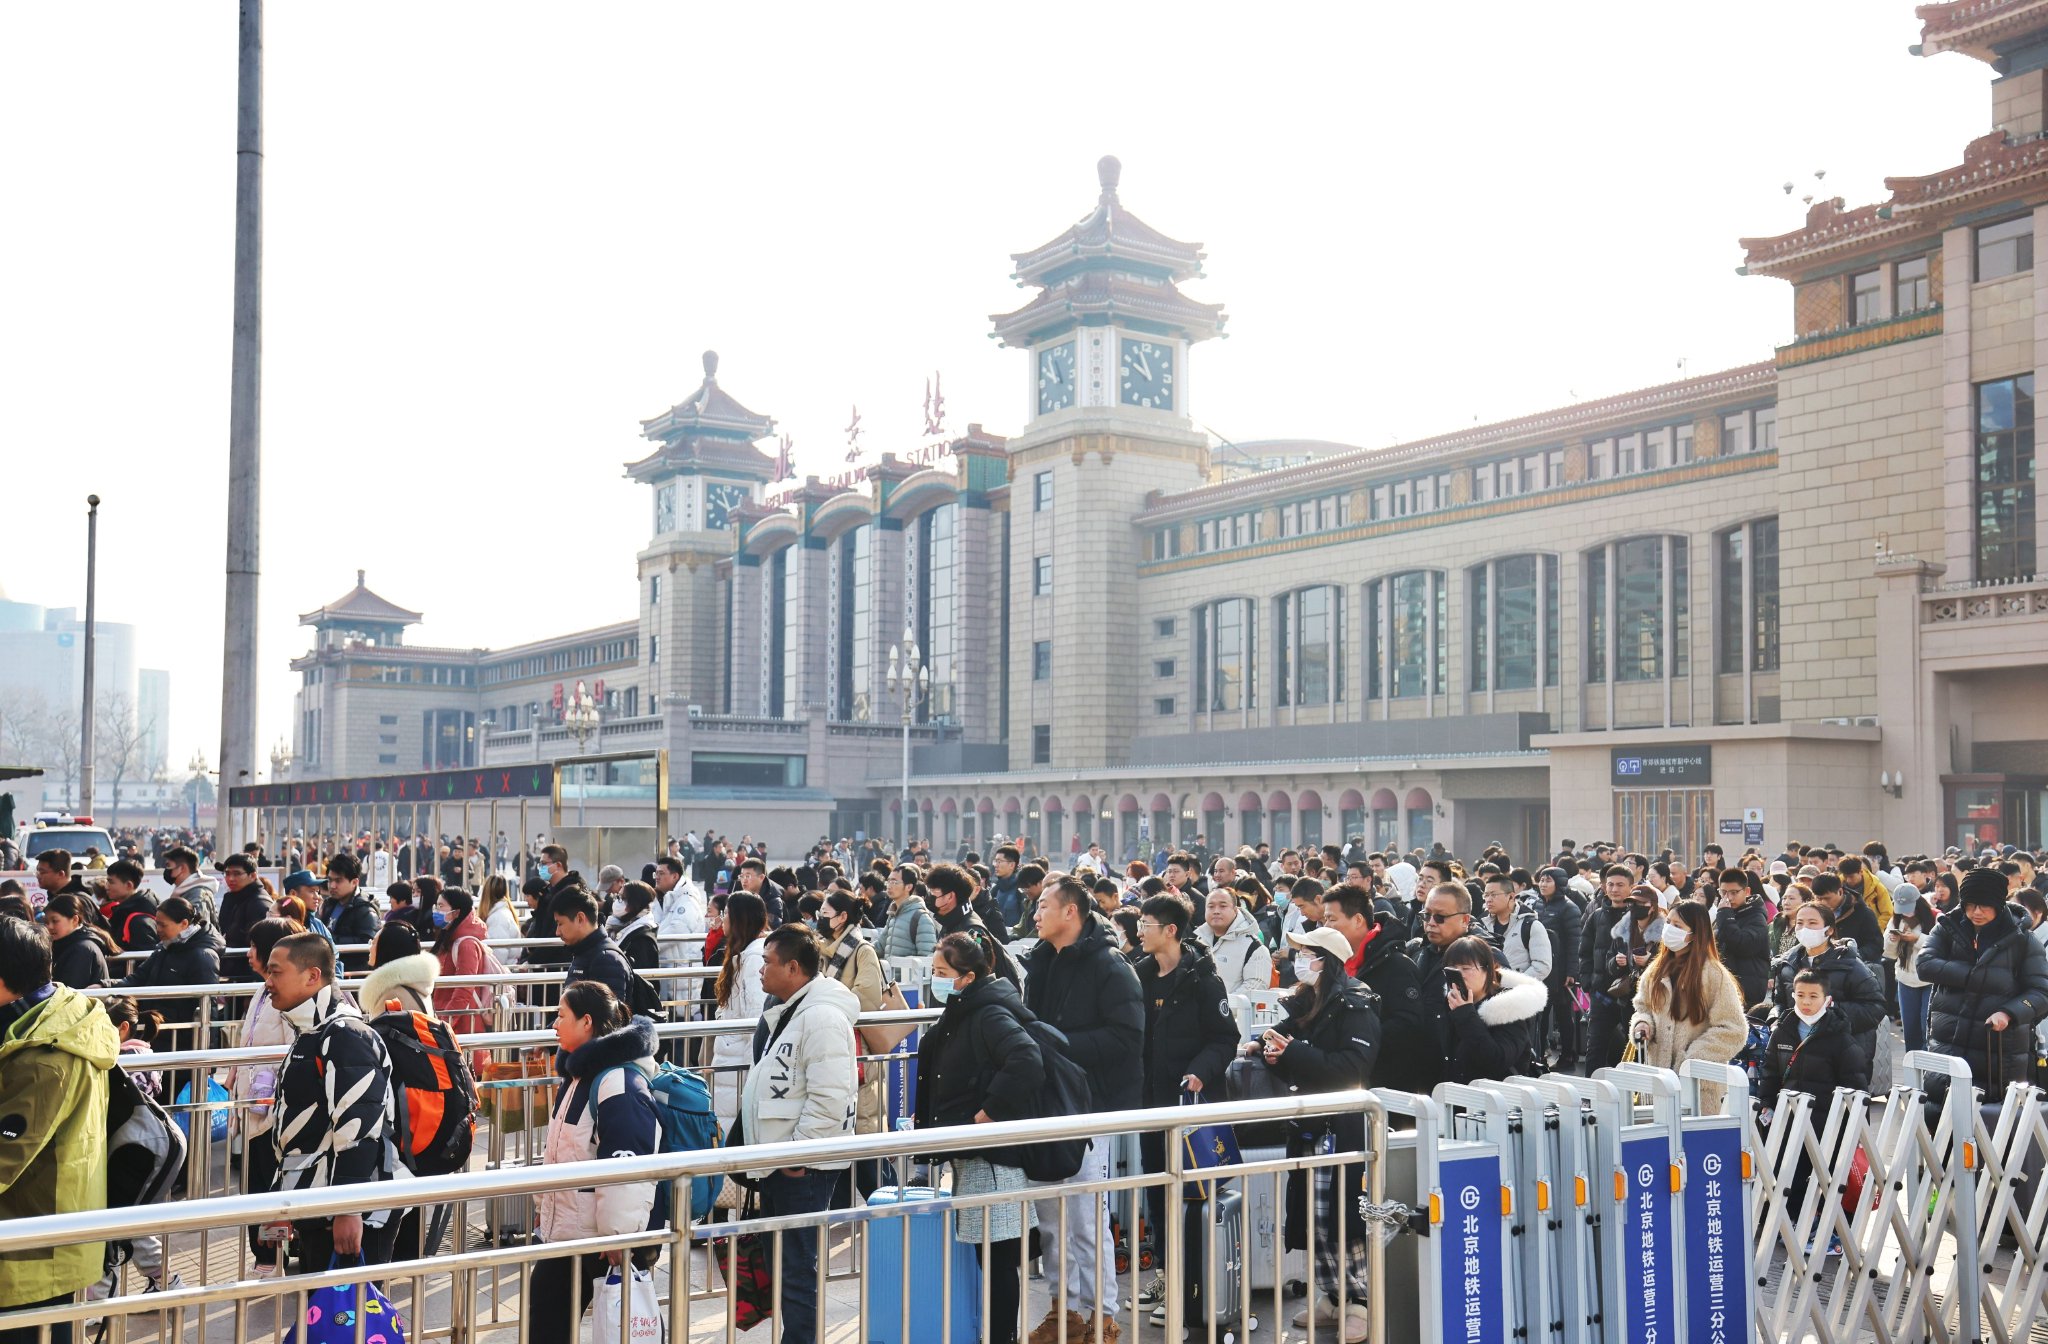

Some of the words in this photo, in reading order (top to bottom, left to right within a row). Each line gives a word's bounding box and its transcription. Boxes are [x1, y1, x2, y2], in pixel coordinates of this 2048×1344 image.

[906, 440, 956, 468] STATIO
[1462, 1214, 1481, 1344] 北京地铁运营
